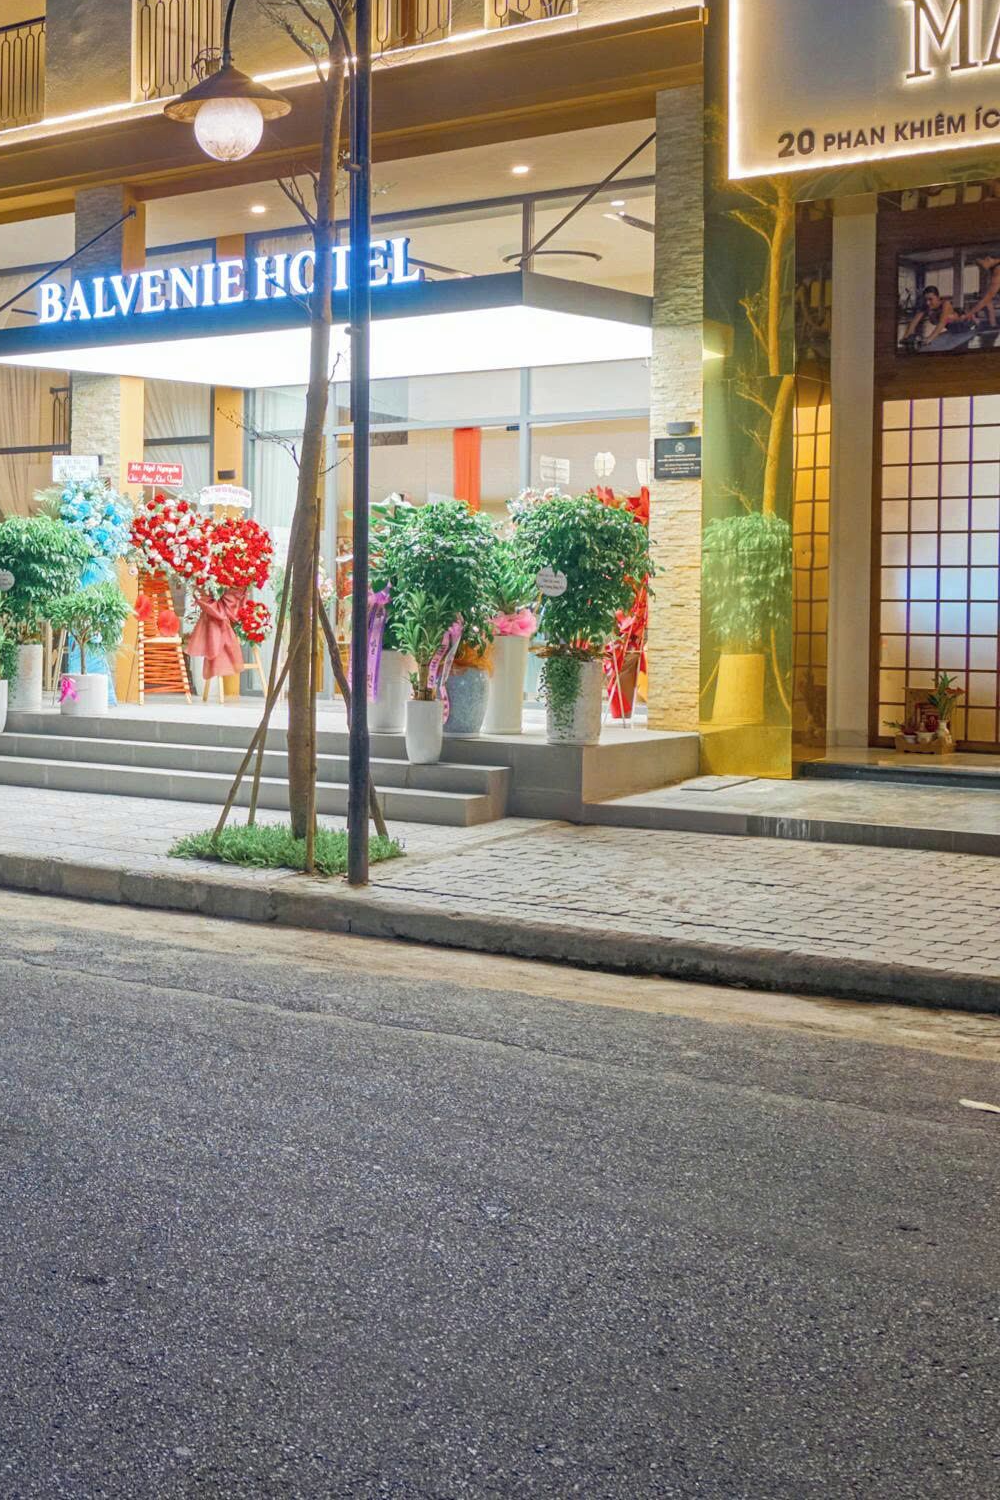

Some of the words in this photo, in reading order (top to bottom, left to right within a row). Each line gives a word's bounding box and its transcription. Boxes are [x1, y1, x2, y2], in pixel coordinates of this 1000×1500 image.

[777, 129, 815, 158] 20
[823, 126, 885, 152] PHAN
[894, 111, 966, 142] KHIÊM
[39, 259, 246, 324] BALVENIE
[254, 237, 421, 300] HOTEL
